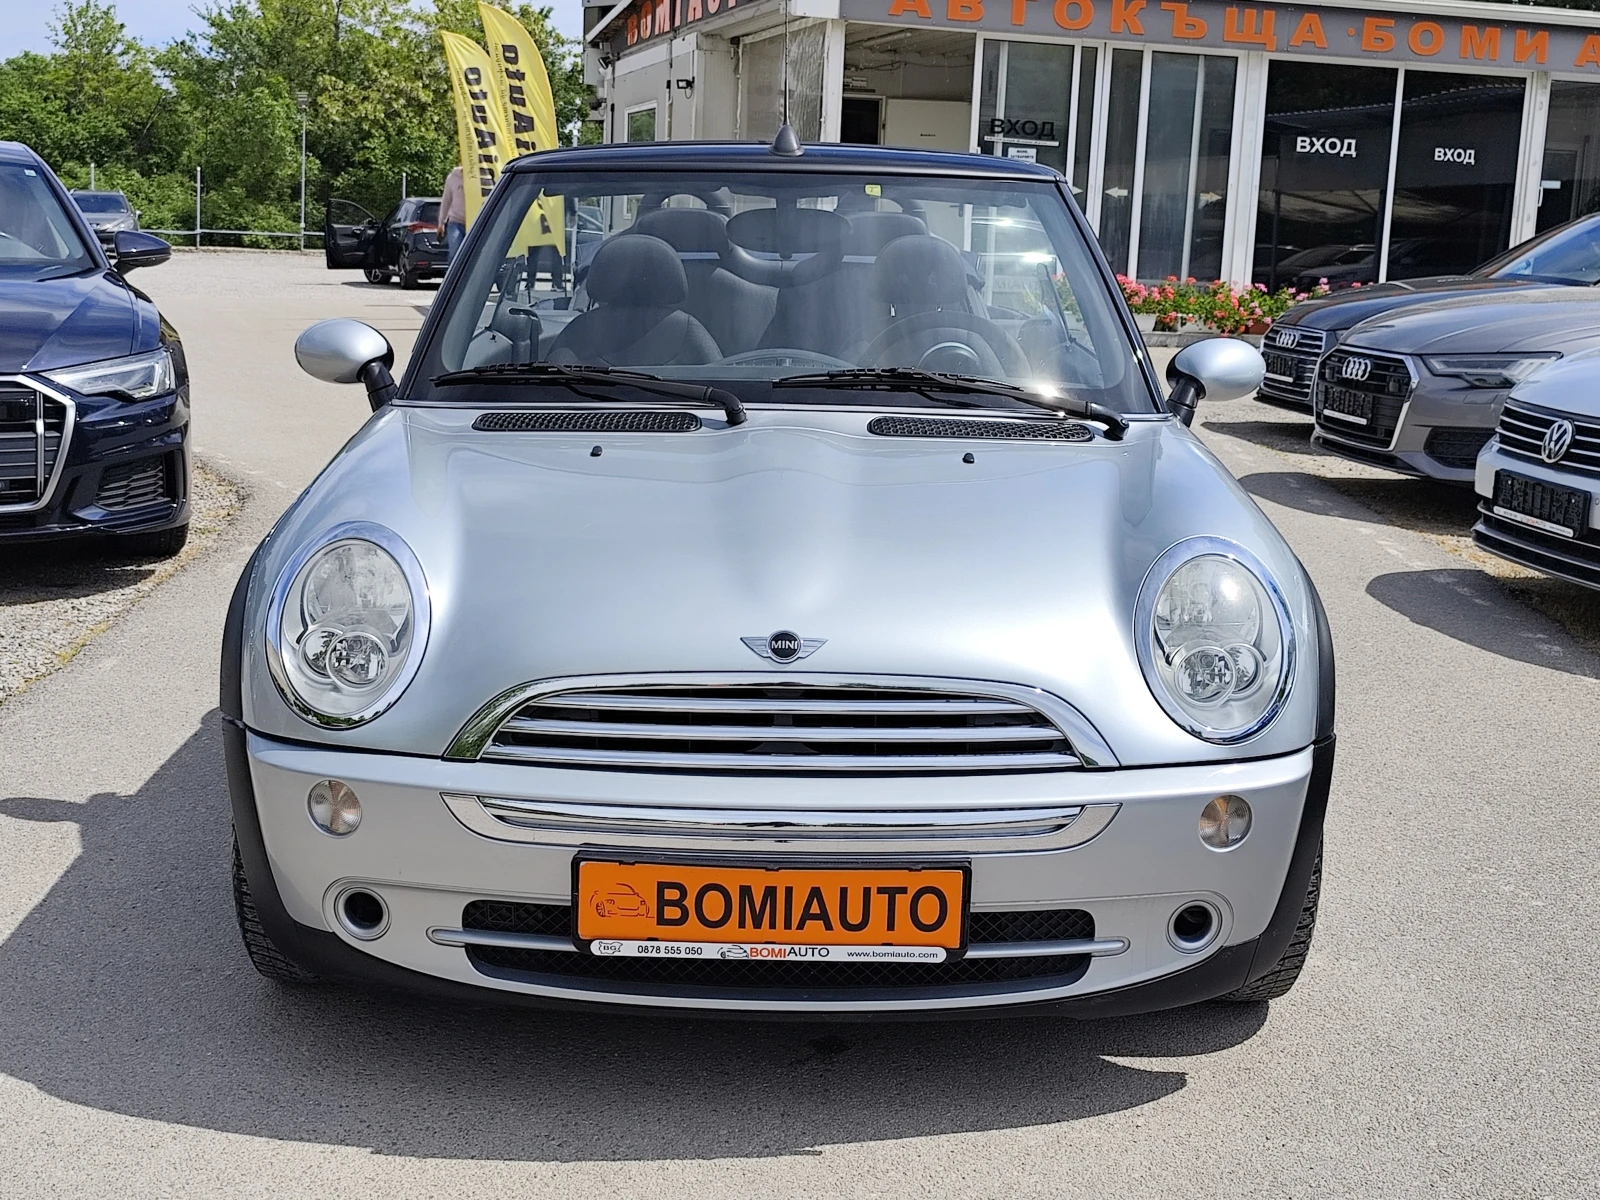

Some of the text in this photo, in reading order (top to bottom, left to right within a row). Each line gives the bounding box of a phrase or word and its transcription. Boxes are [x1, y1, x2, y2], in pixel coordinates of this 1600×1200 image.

[990, 118, 1055, 140] ВХОД
[1295, 136, 1357, 158] ВХОД
[1434, 147, 1476, 165] ВХОД
[771, 640, 798, 650] MINI
[656, 880, 949, 933] BOMIAUTO
[637, 945, 661, 954] 0878
[664, 946, 682, 955] 555
[684, 946, 703, 955] 050
[749, 946, 830, 959] BOMIAUTO
[846, 950, 939, 959] www.bomiauto.com
